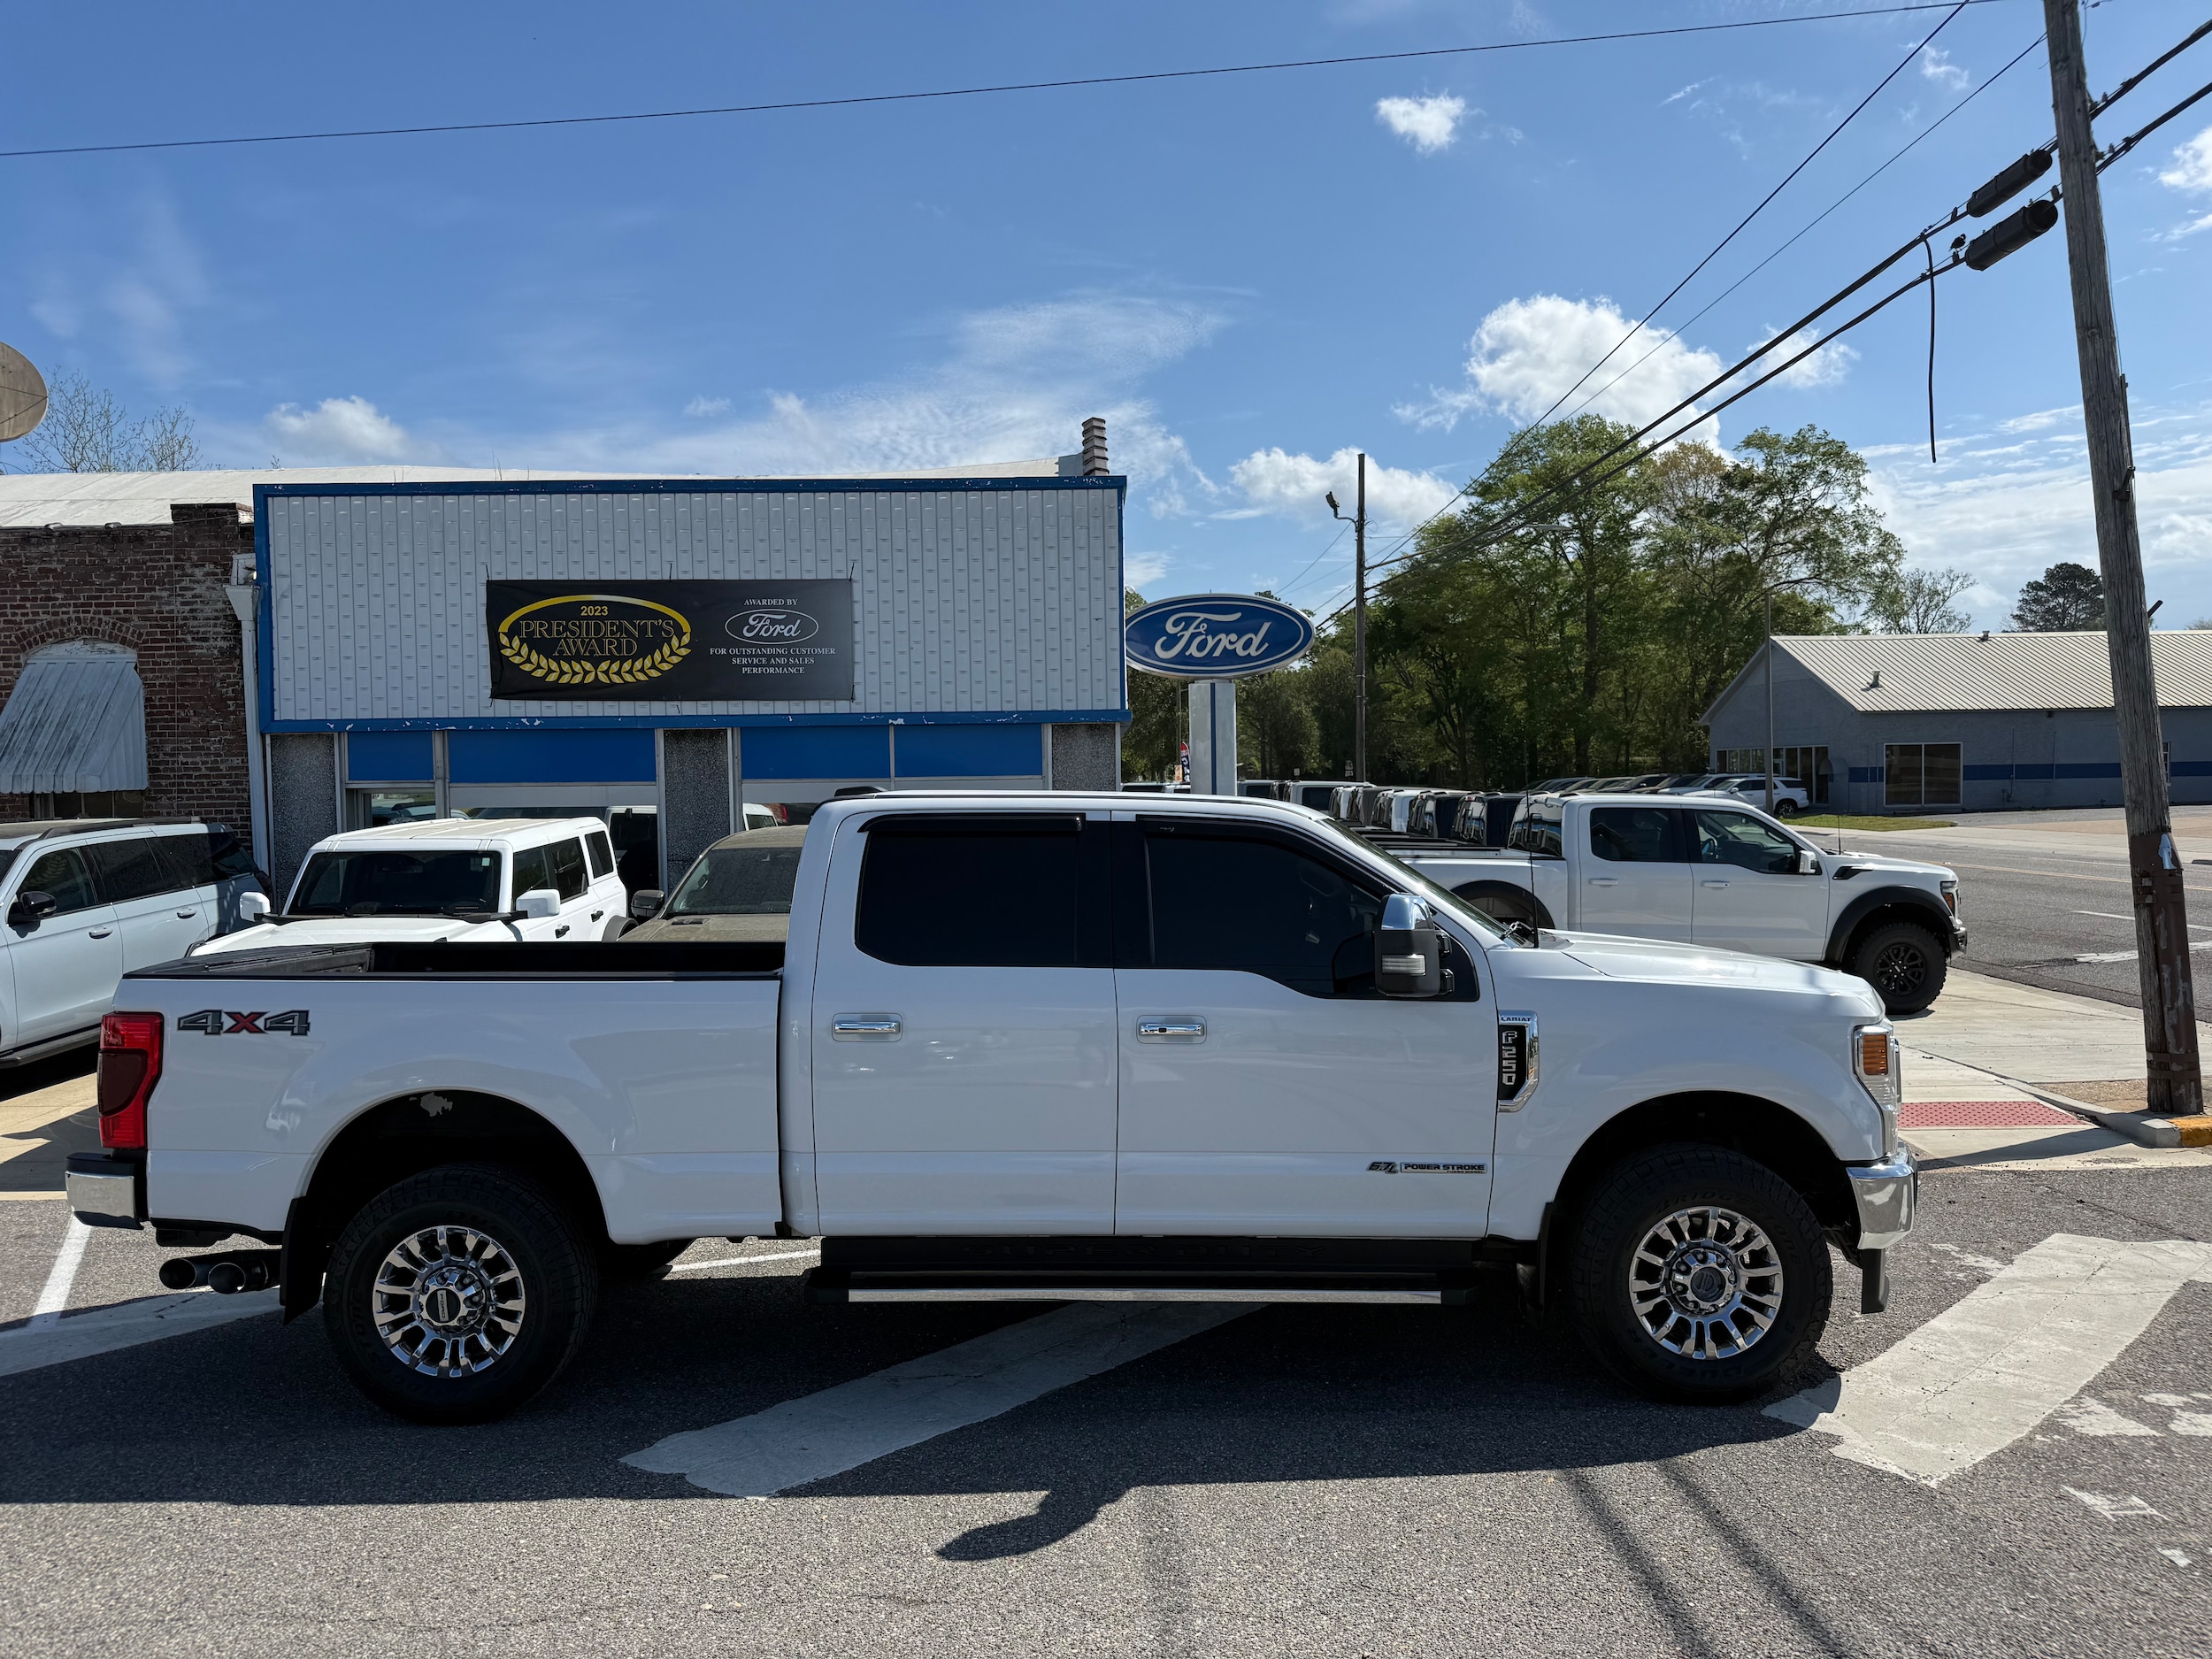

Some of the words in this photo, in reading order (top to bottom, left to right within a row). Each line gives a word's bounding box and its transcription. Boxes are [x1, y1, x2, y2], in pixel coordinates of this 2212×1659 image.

[580, 605, 609, 616] 2023
[519, 619, 674, 639] PRESIDENT'S
[742, 613, 802, 637] Ford
[1154, 611, 1272, 660] Ford
[552, 638, 638, 656] AWARD
[1367, 1161, 1398, 1174] 6.7L
[962, 1244, 1157, 1257] SUPER
[1174, 1244, 1325, 1258] DUTY
